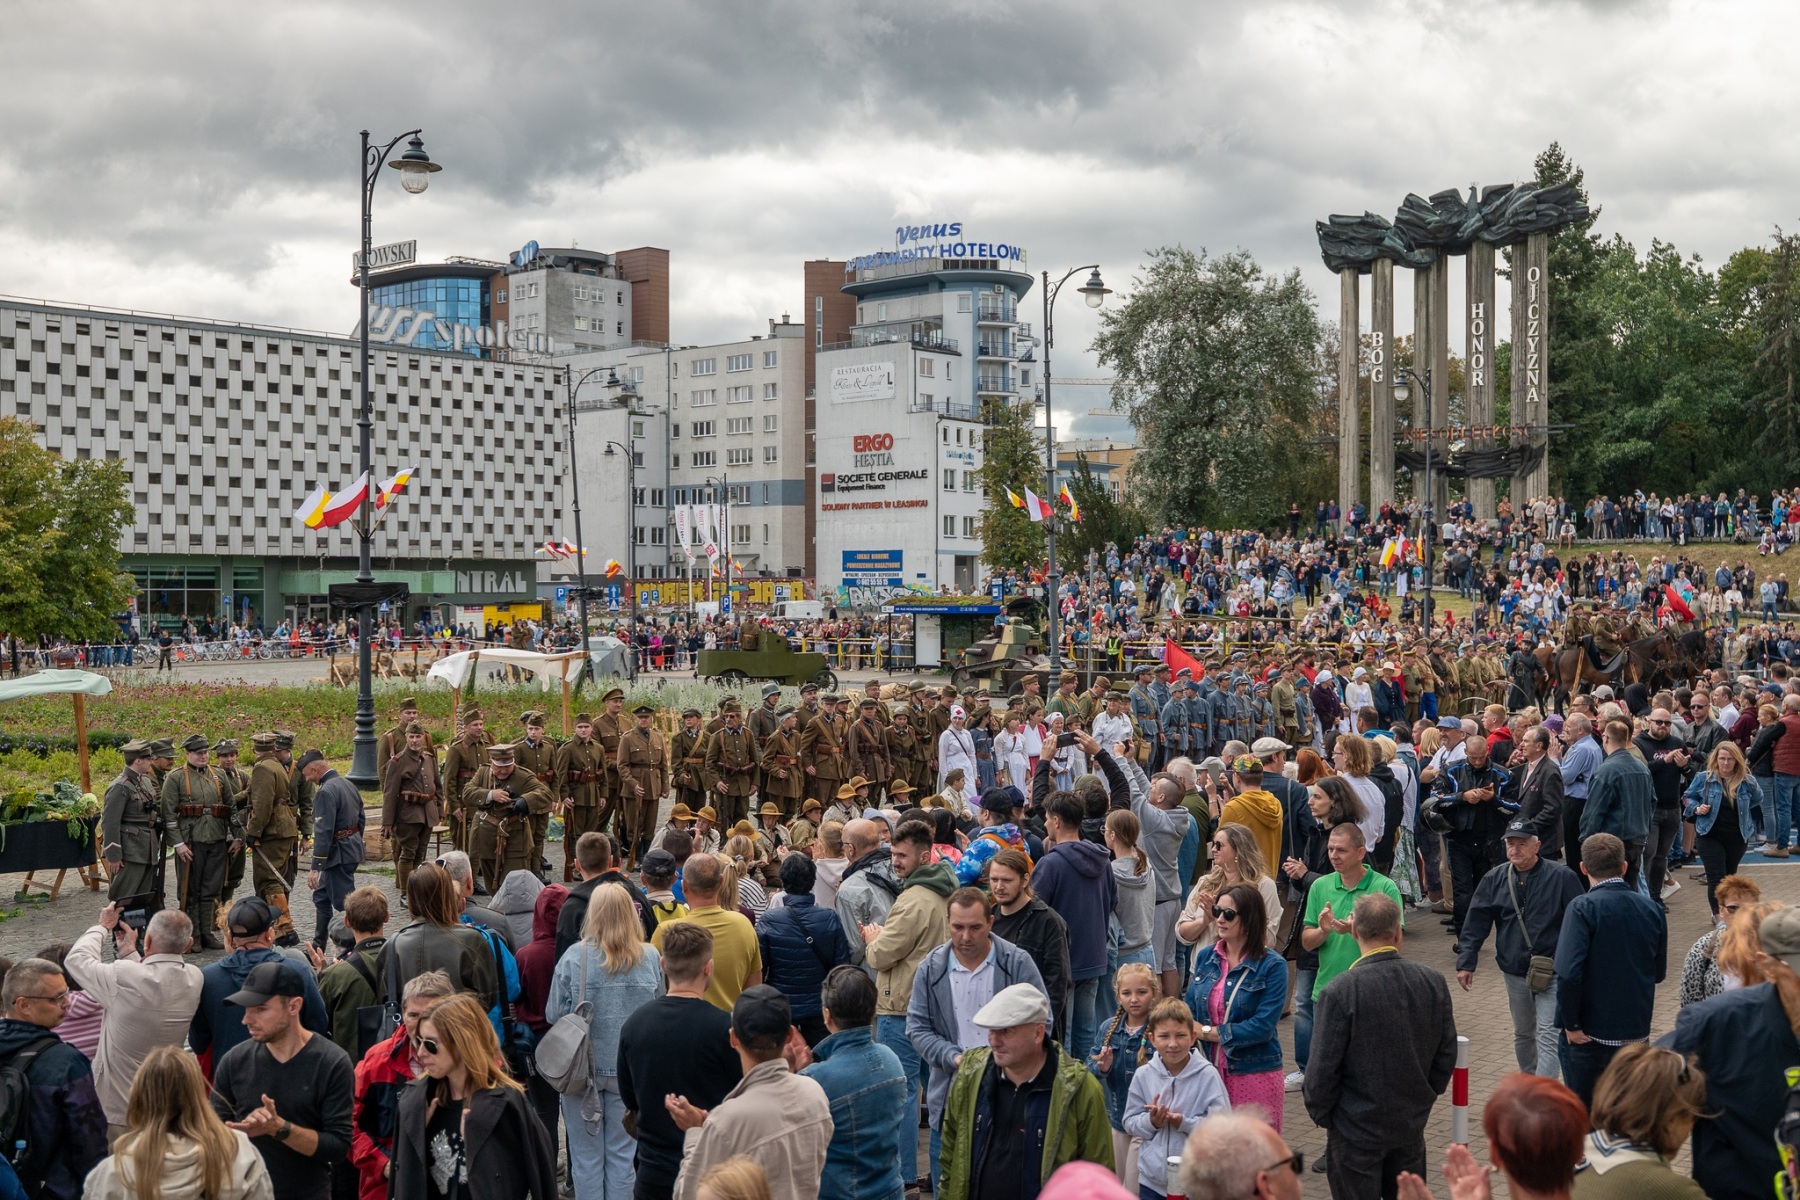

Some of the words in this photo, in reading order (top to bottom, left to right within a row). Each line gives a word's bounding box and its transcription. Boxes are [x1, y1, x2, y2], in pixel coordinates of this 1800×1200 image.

[896, 222, 962, 245] Venus
[353, 242, 412, 271] DOWSKI
[1526, 266, 1540, 402] OJCZYZNA
[1471, 303, 1485, 387] HONOR
[1371, 331, 1384, 383] BÓG
[837, 365, 882, 376] RESTAURACJA
[853, 433, 894, 453] ERGO
[853, 452, 895, 468] HESTIA
[877, 469, 928, 481] GENERALE
[837, 484, 865, 493] Equipment
[865, 483, 886, 491] Finance
[851, 501, 883, 510] PARTNER
[884, 500, 891, 509] W
[892, 499, 928, 509] LEASINGU
[457, 570, 527, 593] NTRAL
